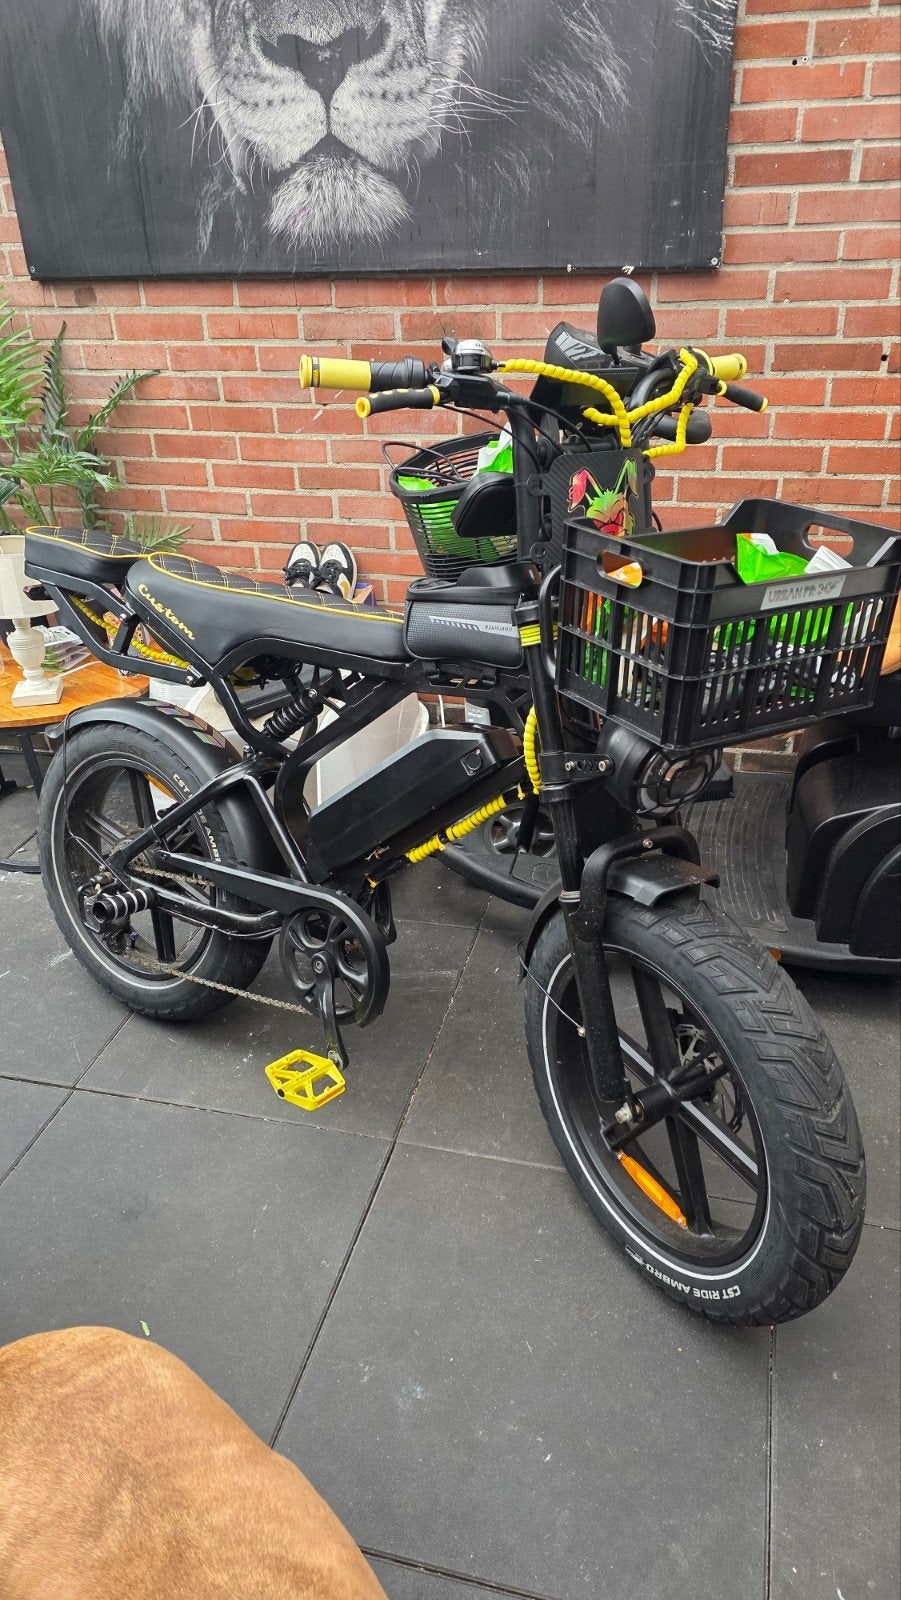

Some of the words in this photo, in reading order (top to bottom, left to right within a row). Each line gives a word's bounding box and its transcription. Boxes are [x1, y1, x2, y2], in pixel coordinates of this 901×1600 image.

[138, 583, 196, 640] Custom
[172, 773, 191, 793] CST
[645, 1264, 691, 1294] AMBRO
[692, 1287, 721, 1300] RIDE
[722, 1285, 741, 1300] CST
